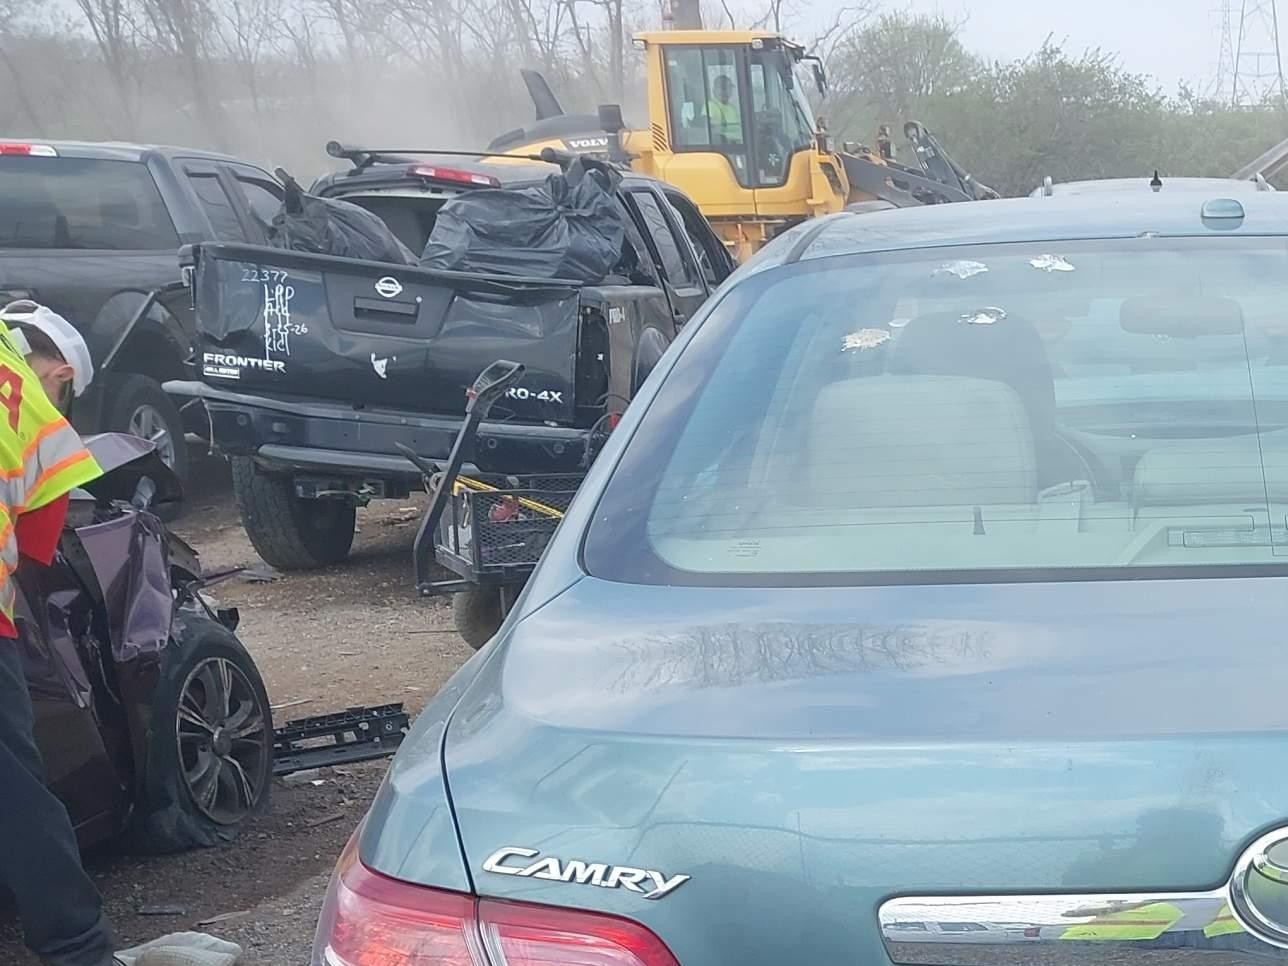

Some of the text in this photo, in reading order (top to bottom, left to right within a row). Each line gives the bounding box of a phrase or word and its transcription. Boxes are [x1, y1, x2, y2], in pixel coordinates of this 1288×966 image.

[569, 137, 609, 148] VOLV
[241, 269, 289, 283] 22377
[203, 352, 288, 374] FRONTIER
[505, 387, 564, 404] RO-4X
[481, 846, 692, 899] CAMRY
